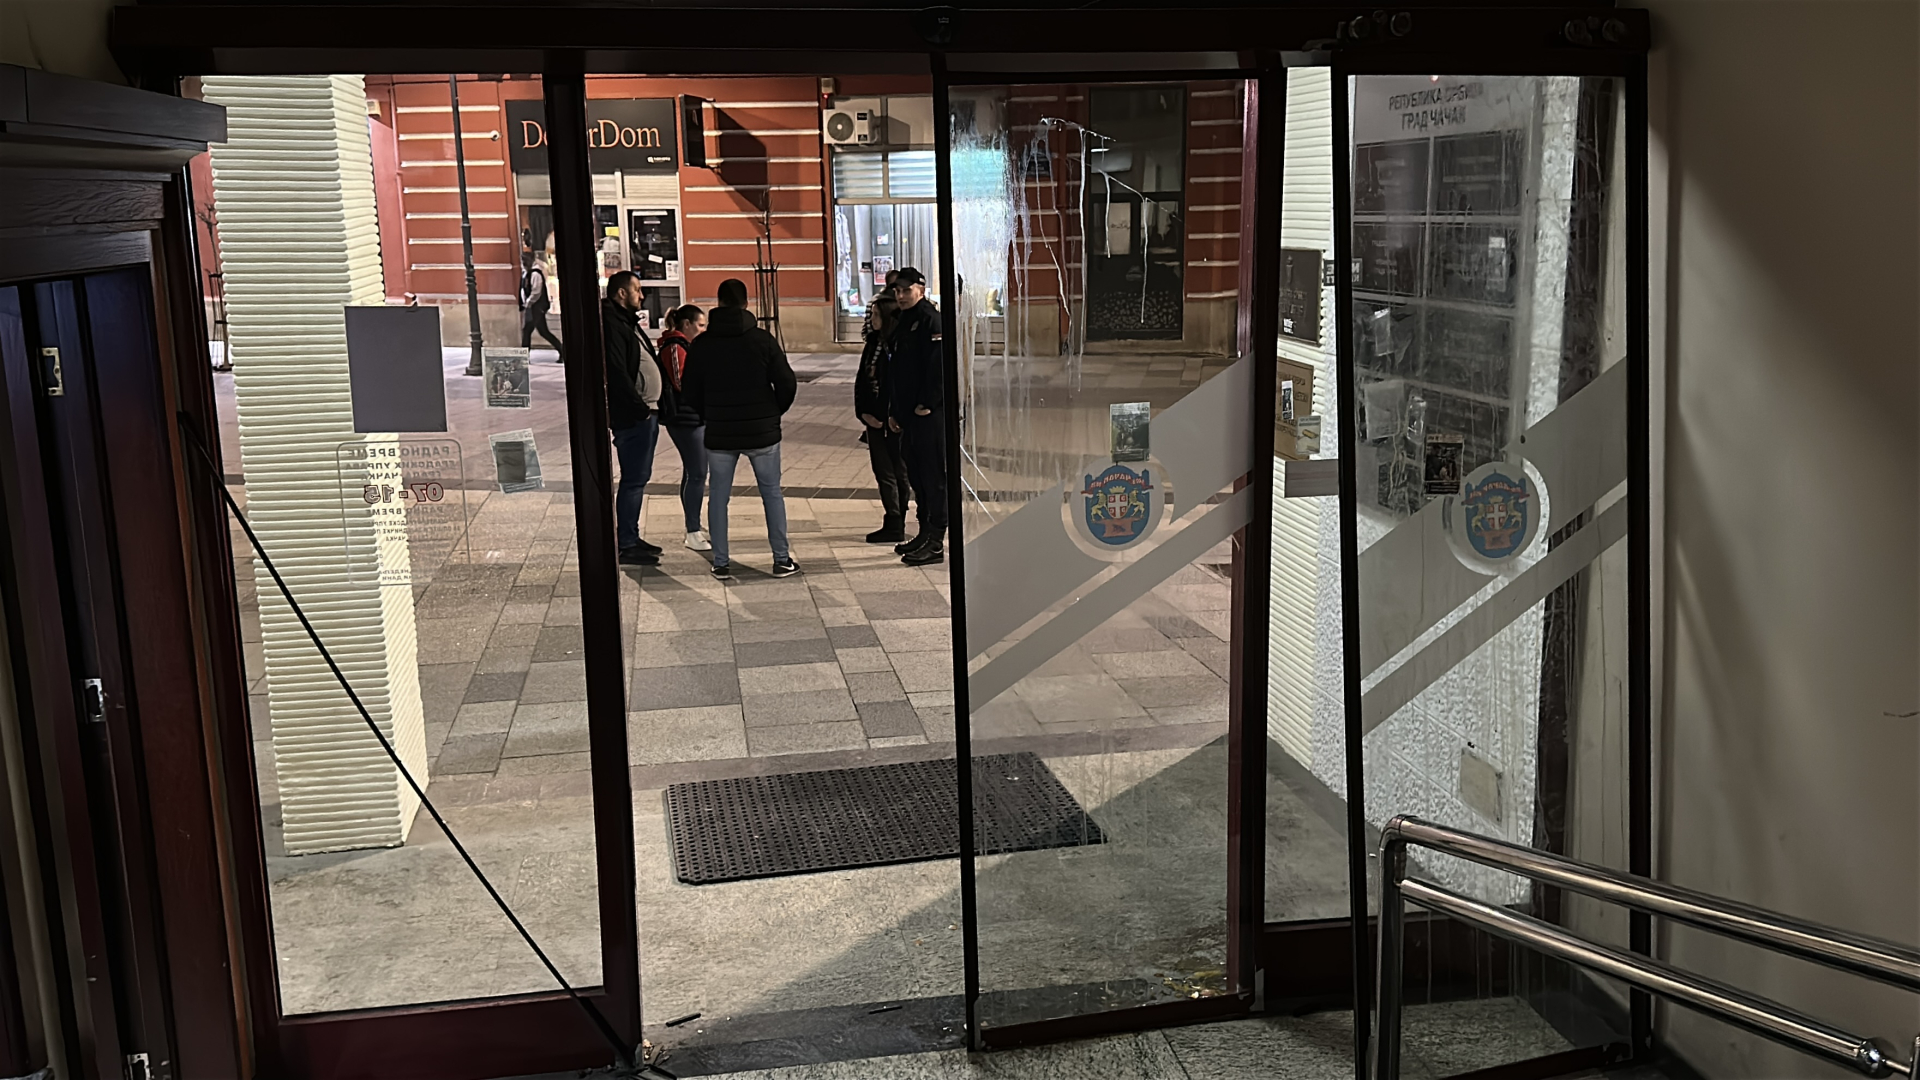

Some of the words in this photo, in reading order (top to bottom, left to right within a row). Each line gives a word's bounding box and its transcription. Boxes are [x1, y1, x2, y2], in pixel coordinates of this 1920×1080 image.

[1388, 87, 1442, 111] РЕПУБЛИКА
[1401, 109, 1429, 132] ГРАД
[1430, 106, 1467, 127] ЧАЧАК
